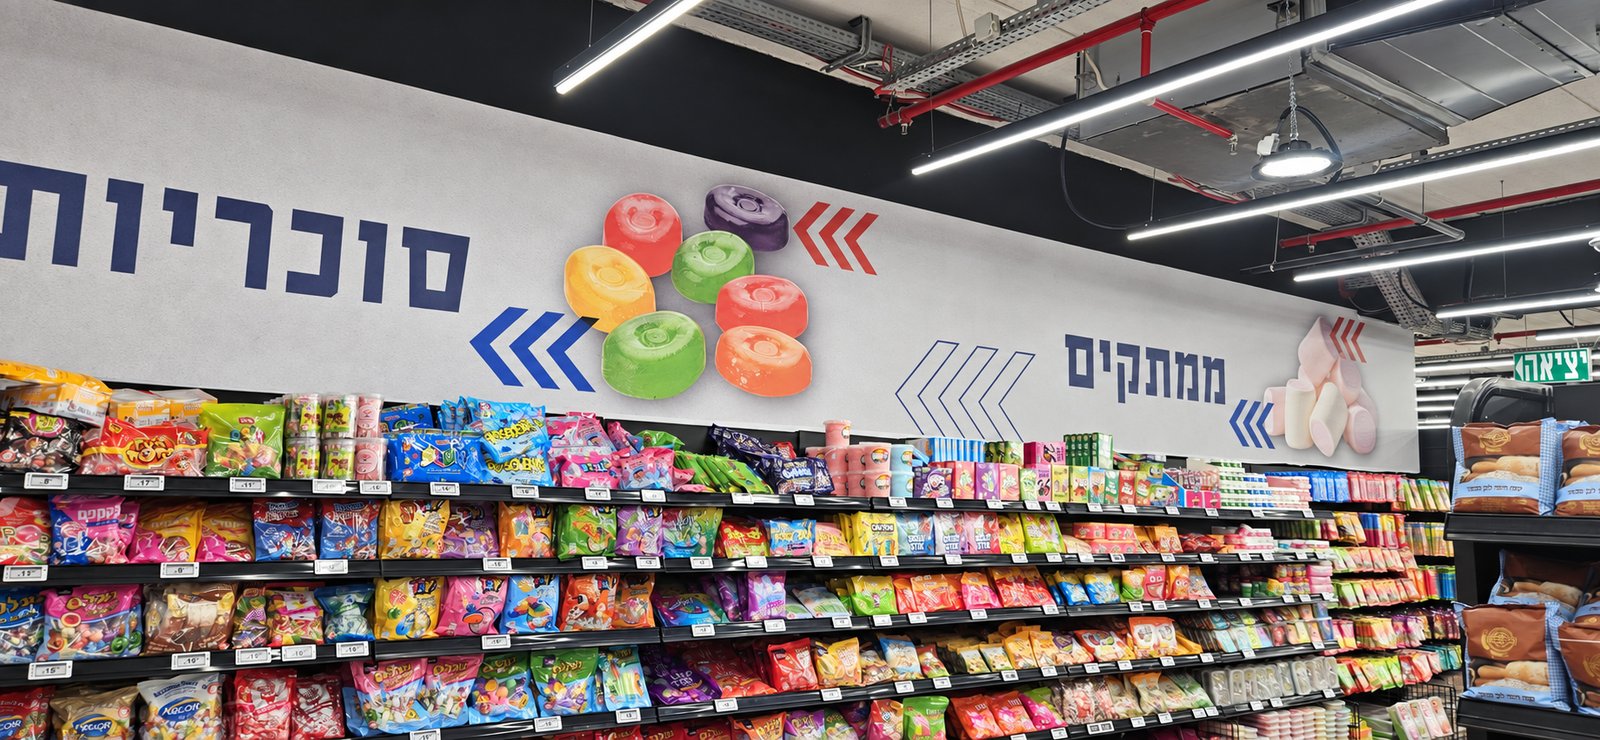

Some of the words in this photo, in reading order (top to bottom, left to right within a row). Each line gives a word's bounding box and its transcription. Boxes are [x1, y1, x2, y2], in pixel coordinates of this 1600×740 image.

[0, 160, 470, 312] סוכריות
[1065, 334, 1226, 404] ממתקים
[1525, 351, 1587, 381] יציאה
